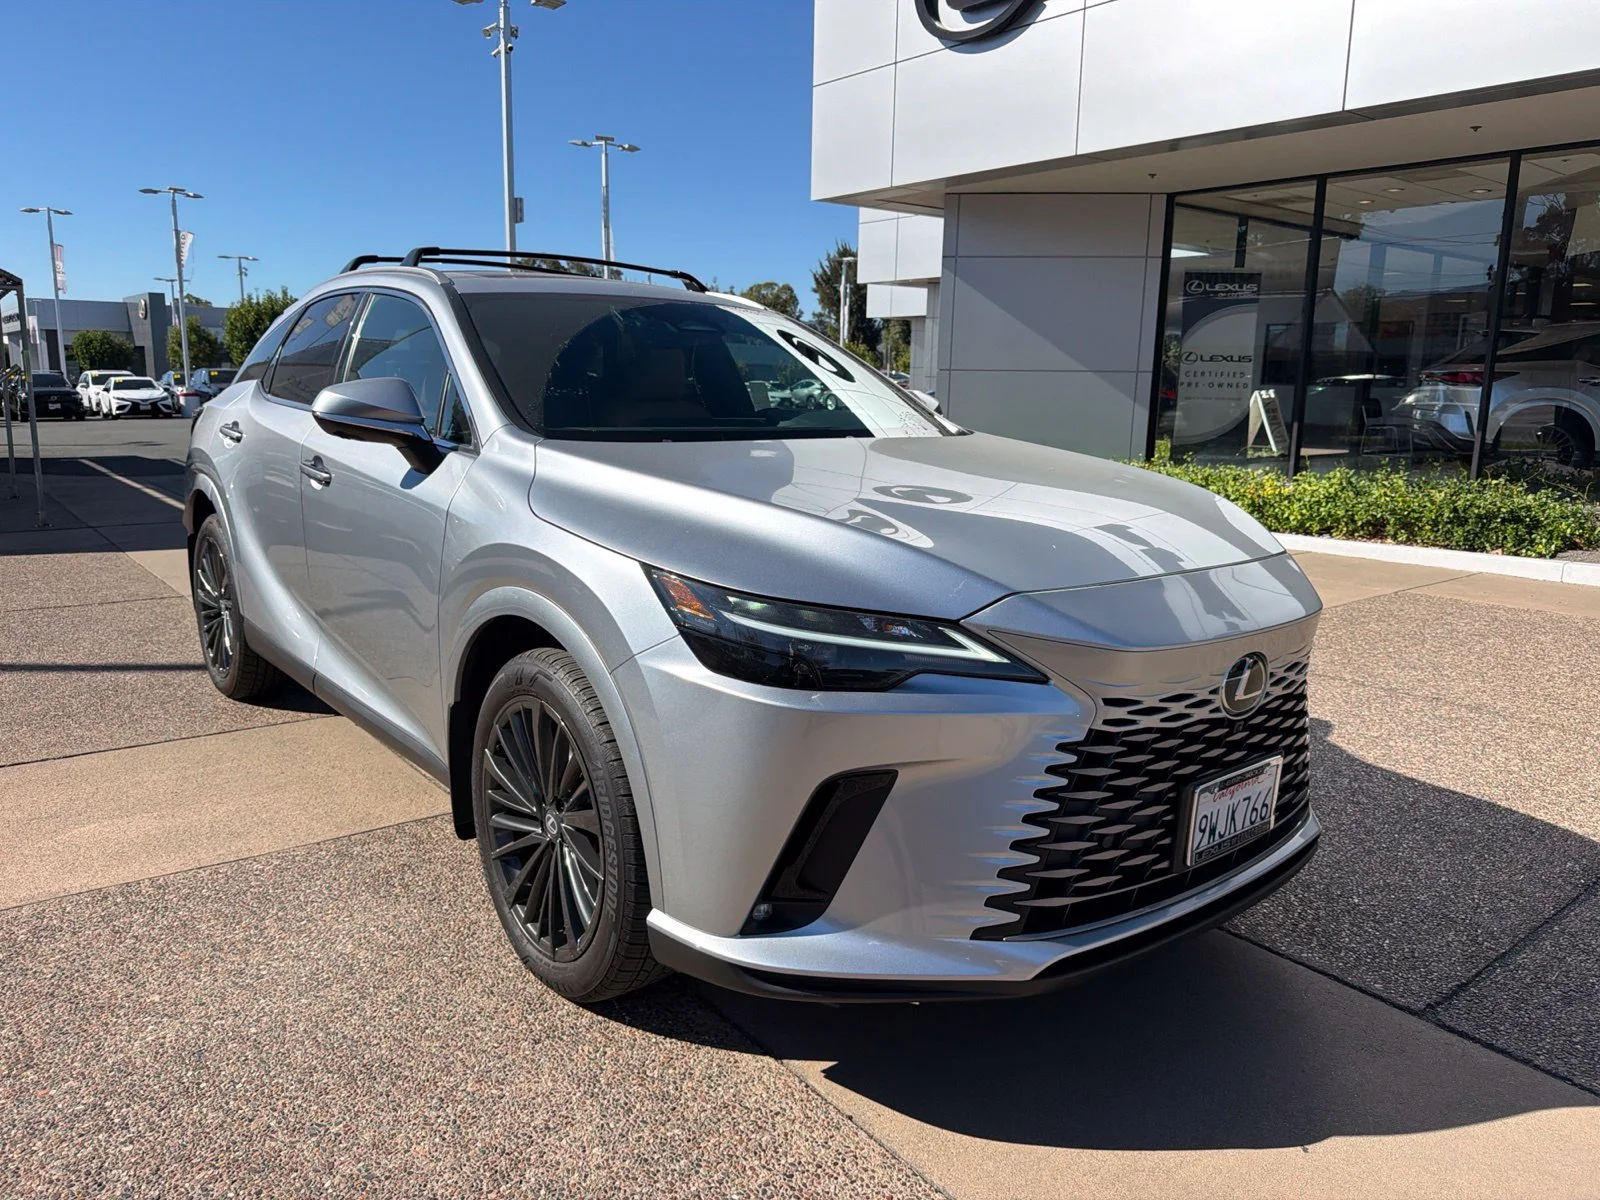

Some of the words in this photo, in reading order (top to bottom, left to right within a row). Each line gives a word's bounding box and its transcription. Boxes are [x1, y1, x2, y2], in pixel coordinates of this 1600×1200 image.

[1205, 283, 1258, 292] LEXUS
[1200, 354, 1253, 363] LEXUS
[1185, 370, 1246, 378] CERTIFIED
[1180, 381, 1249, 389] PRE-OWNED
[1212, 777, 1264, 803] California
[1195, 786, 1272, 851] 9WJK766
